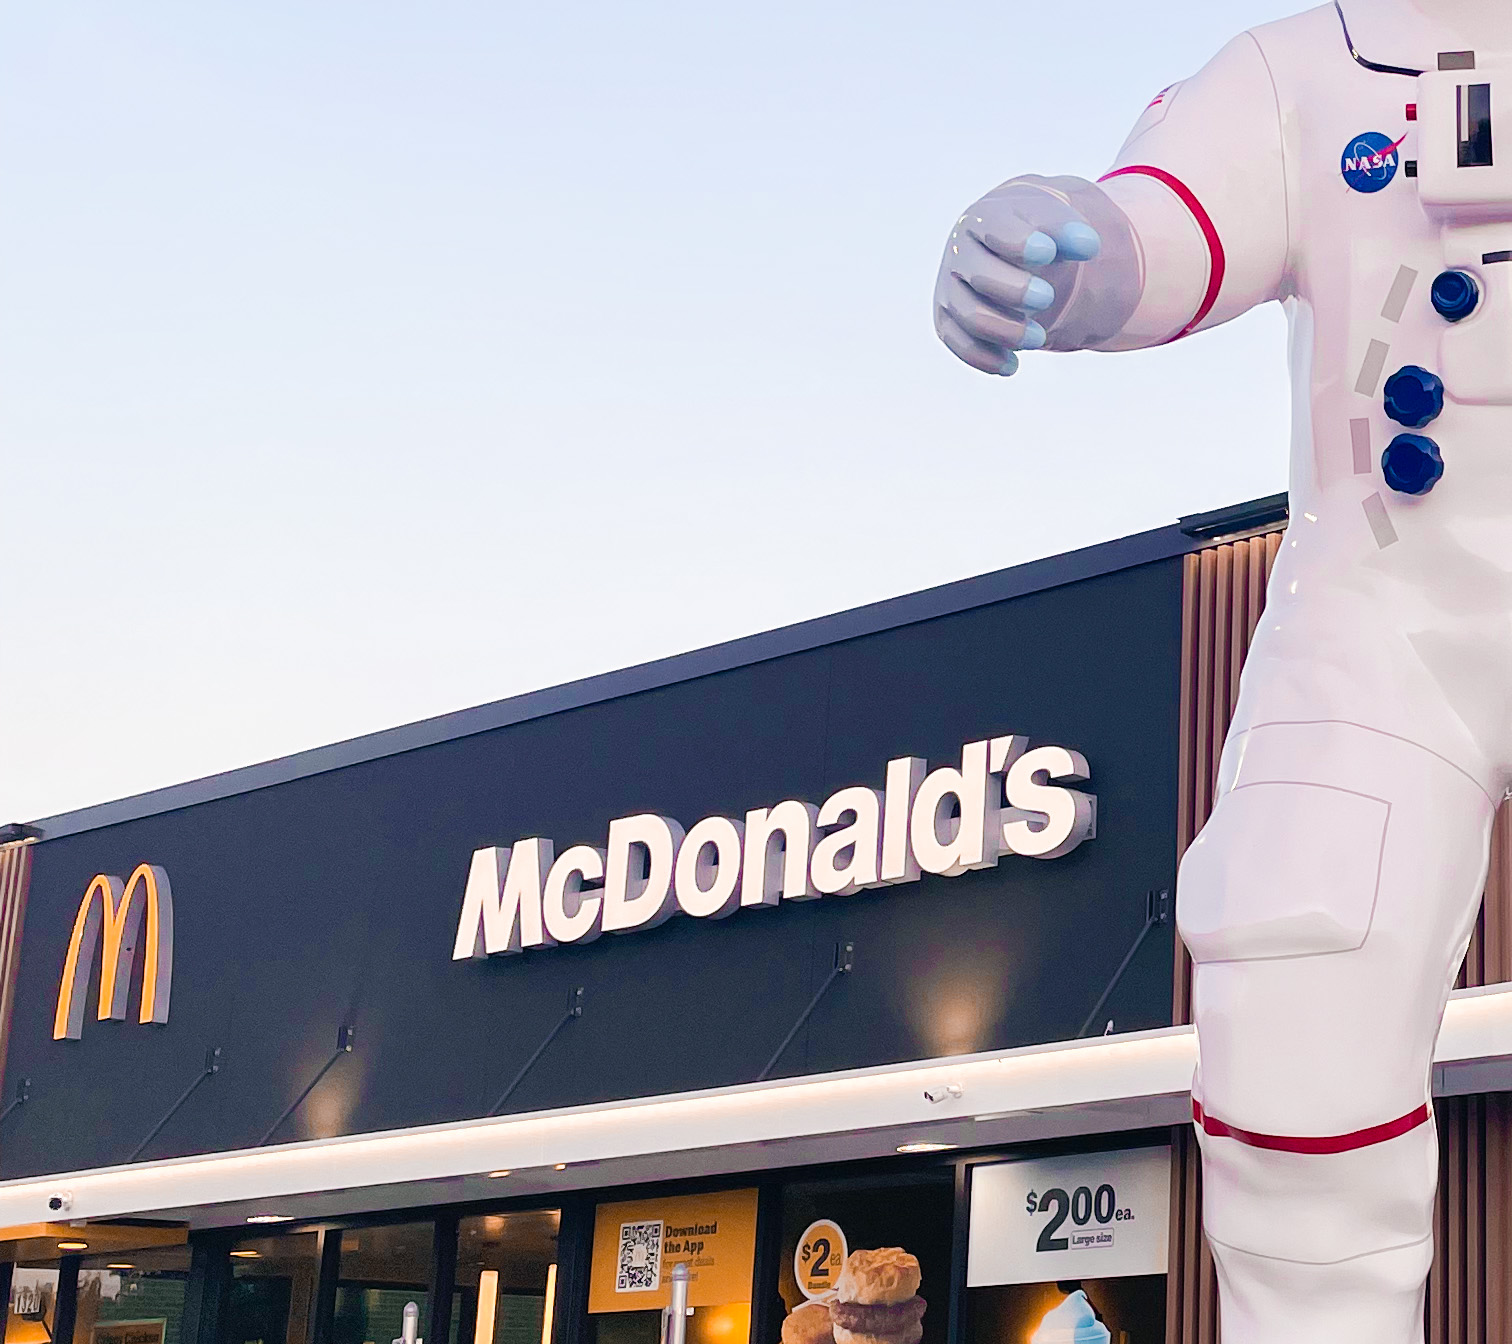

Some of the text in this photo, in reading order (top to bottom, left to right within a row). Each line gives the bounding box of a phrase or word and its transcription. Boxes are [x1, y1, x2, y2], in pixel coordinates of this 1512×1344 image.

[1342, 152, 1397, 173] NASA
[451, 734, 1093, 961] McDonald's
[665, 1220, 718, 1238] Download
[664, 1239, 705, 1256] the App
[1072, 1231, 1113, 1247] Large size
